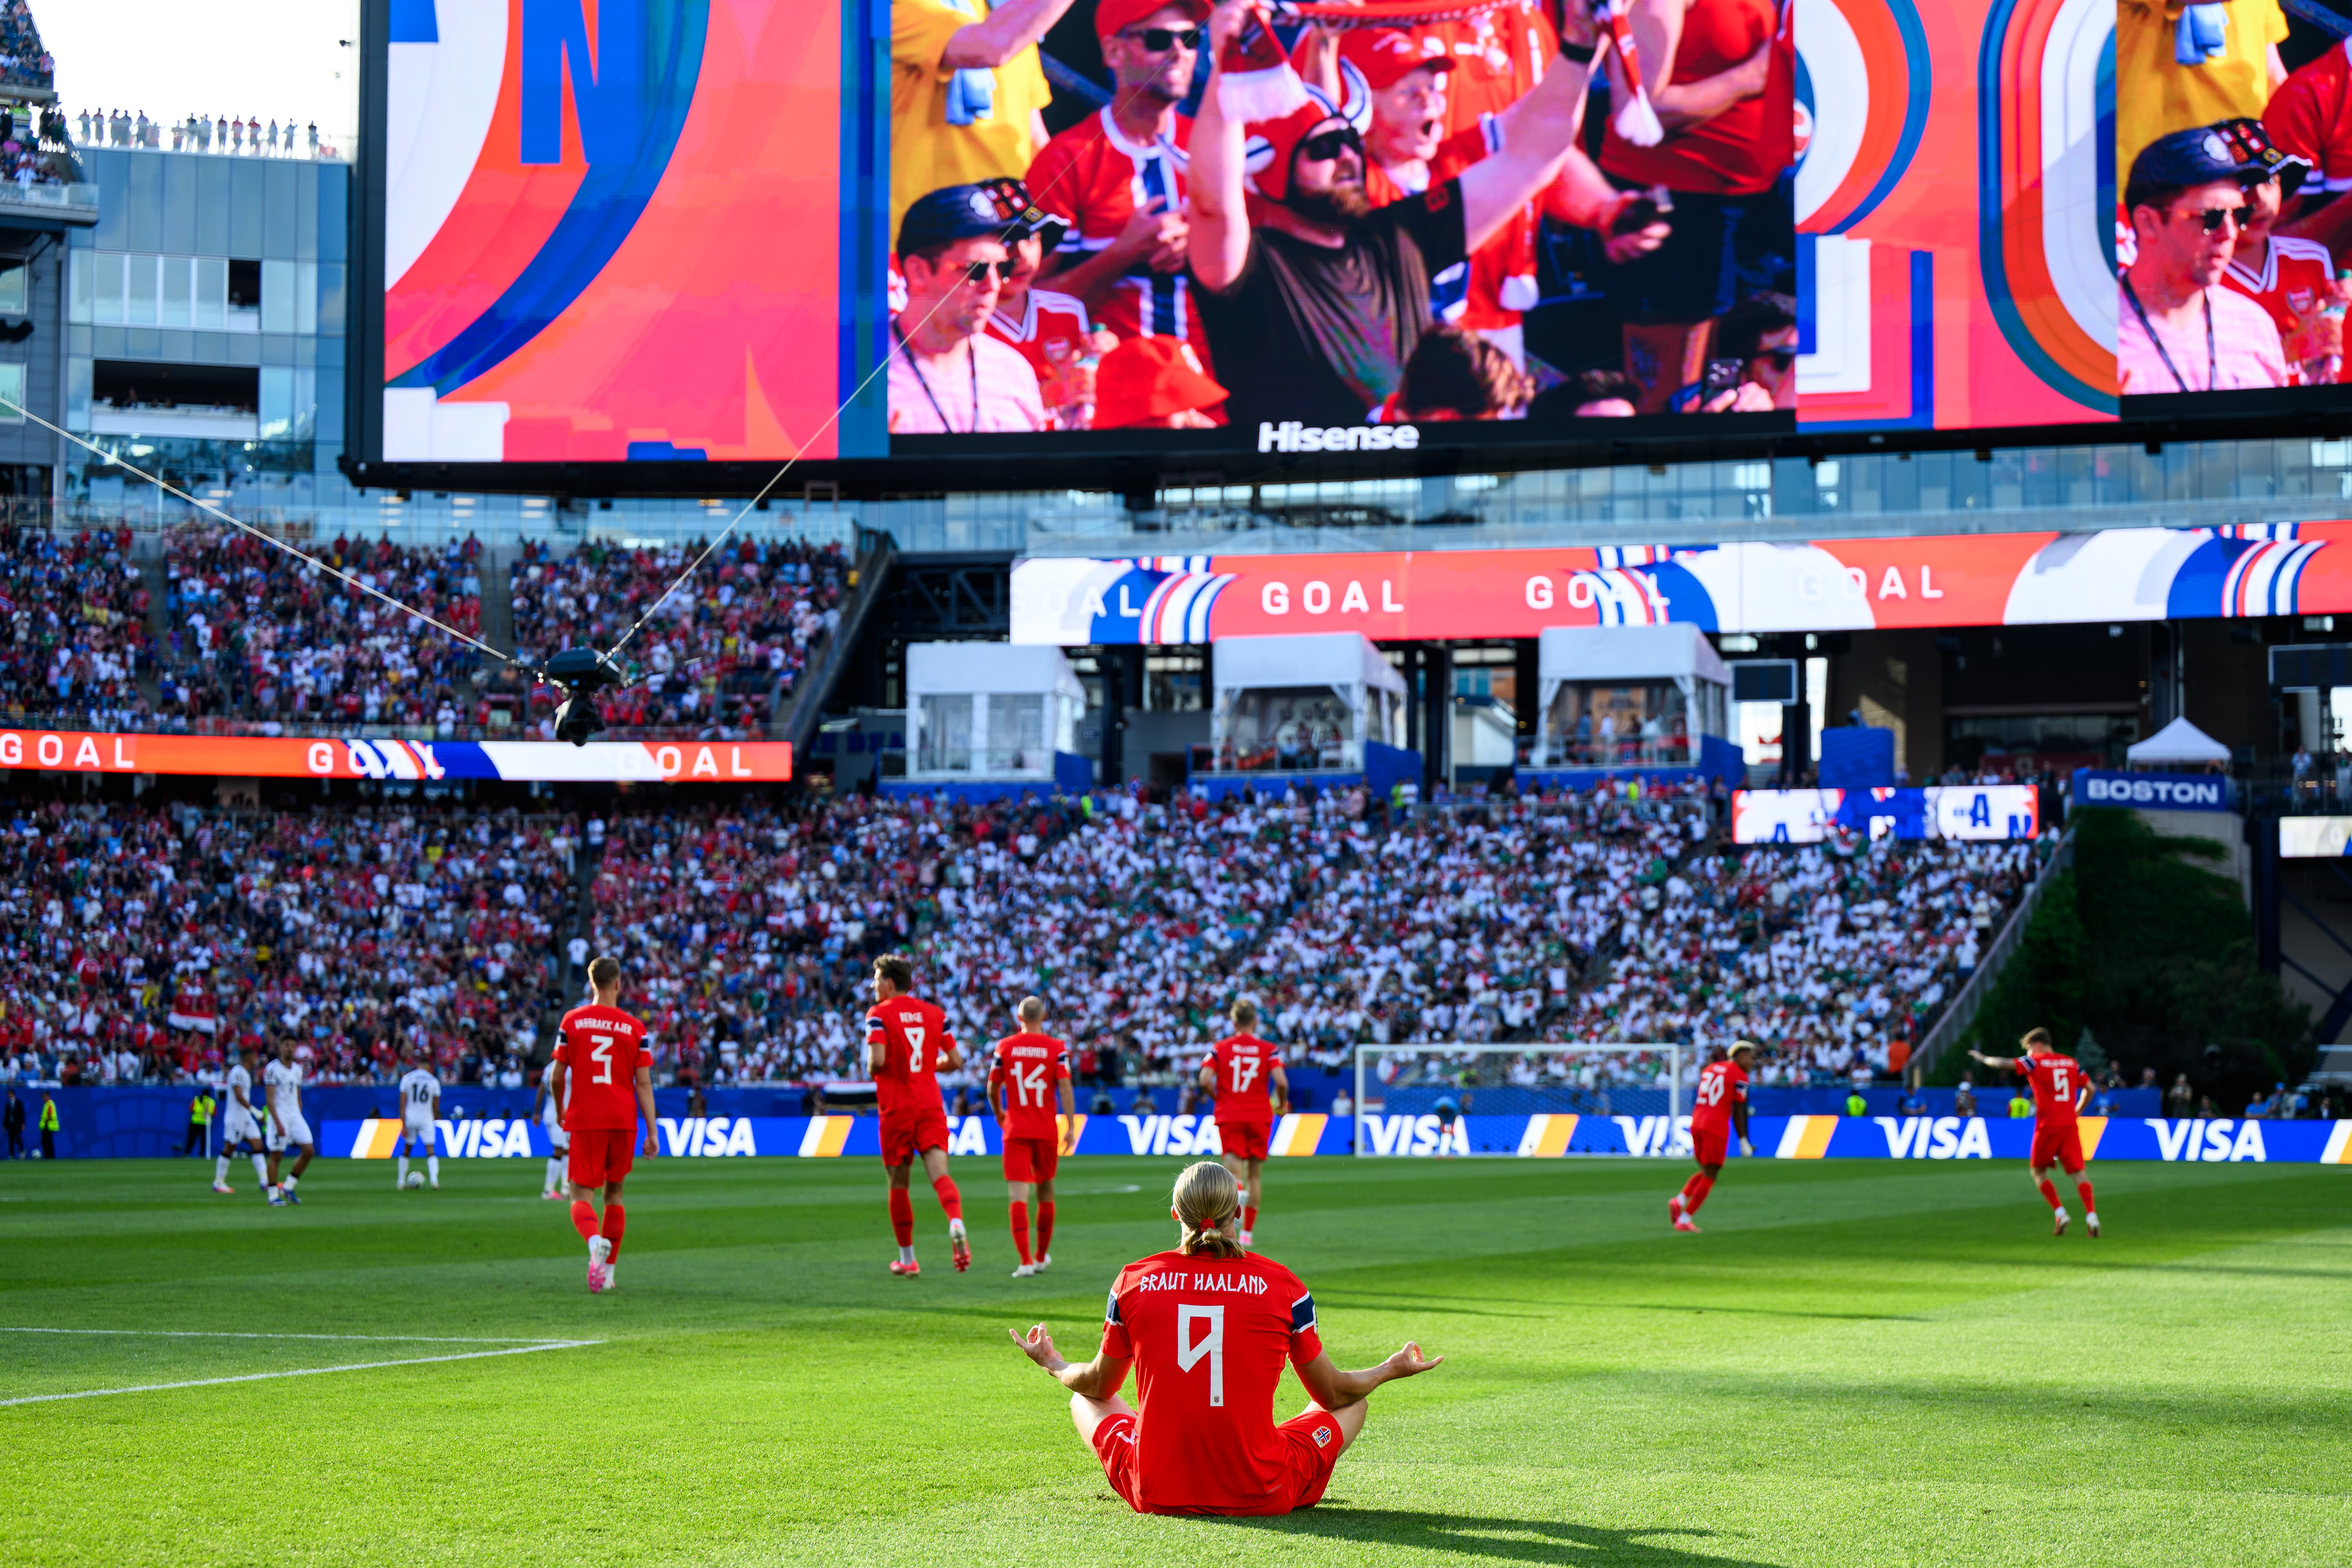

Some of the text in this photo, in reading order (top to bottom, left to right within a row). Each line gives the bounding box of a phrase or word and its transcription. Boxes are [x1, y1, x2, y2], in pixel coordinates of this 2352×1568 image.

[1258, 421, 1419, 452] Hisense
[1261, 579, 1405, 615] GOAL
[1797, 565, 1944, 602] GOAL
[0, 733, 135, 768] GOAL
[617, 746, 752, 777] GOAL
[2087, 778, 2219, 804] BOSTON
[591, 1034, 614, 1085] 3
[904, 1027, 926, 1073] 8
[413, 1083, 428, 1103] 16
[1010, 1061, 1047, 1108] 14
[1229, 1055, 1261, 1093] 17
[1696, 1071, 1725, 1107] 20
[2053, 1068, 2070, 1102] 5
[435, 1119, 532, 1158] VISA
[656, 1117, 757, 1156] VISA
[1117, 1114, 1223, 1155] VISA
[1360, 1114, 1470, 1156] VISA
[1611, 1116, 1694, 1157] VIS
[1874, 1116, 1992, 1160] VISA
[2144, 1118, 2267, 1162] VISA
[1140, 1272, 1268, 1295] BRAUT HAALAND
[1177, 1303, 1225, 1406] 9
